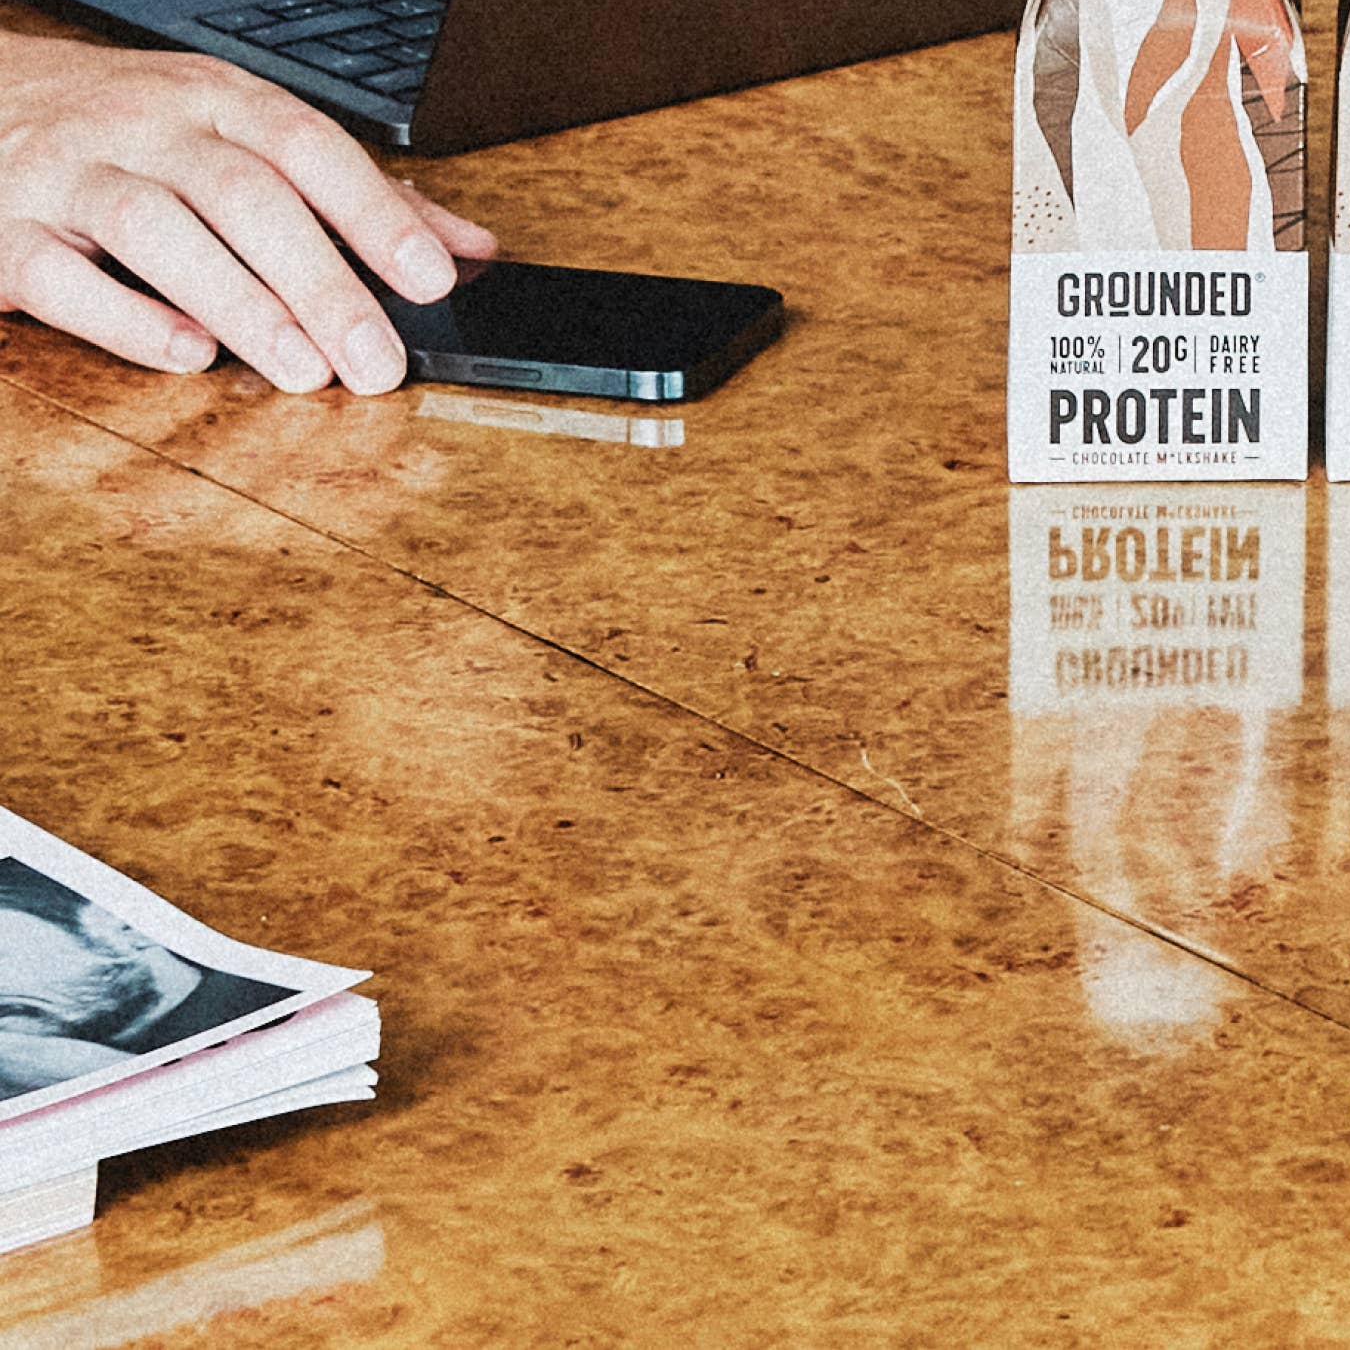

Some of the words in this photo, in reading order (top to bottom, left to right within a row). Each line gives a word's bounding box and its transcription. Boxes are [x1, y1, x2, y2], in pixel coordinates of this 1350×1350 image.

[1057, 271, 1252, 318] GROUNDED
[1050, 335, 1105, 359] 100%
[1131, 334, 1188, 374] 20G
[1209, 334, 1260, 354] DAIRY
[1050, 360, 1104, 375] NATURAL
[1209, 355, 1260, 374] FREE
[1049, 388, 1261, 445] PROTEIN
[1072, 451, 1149, 466] CHOCOLATE
